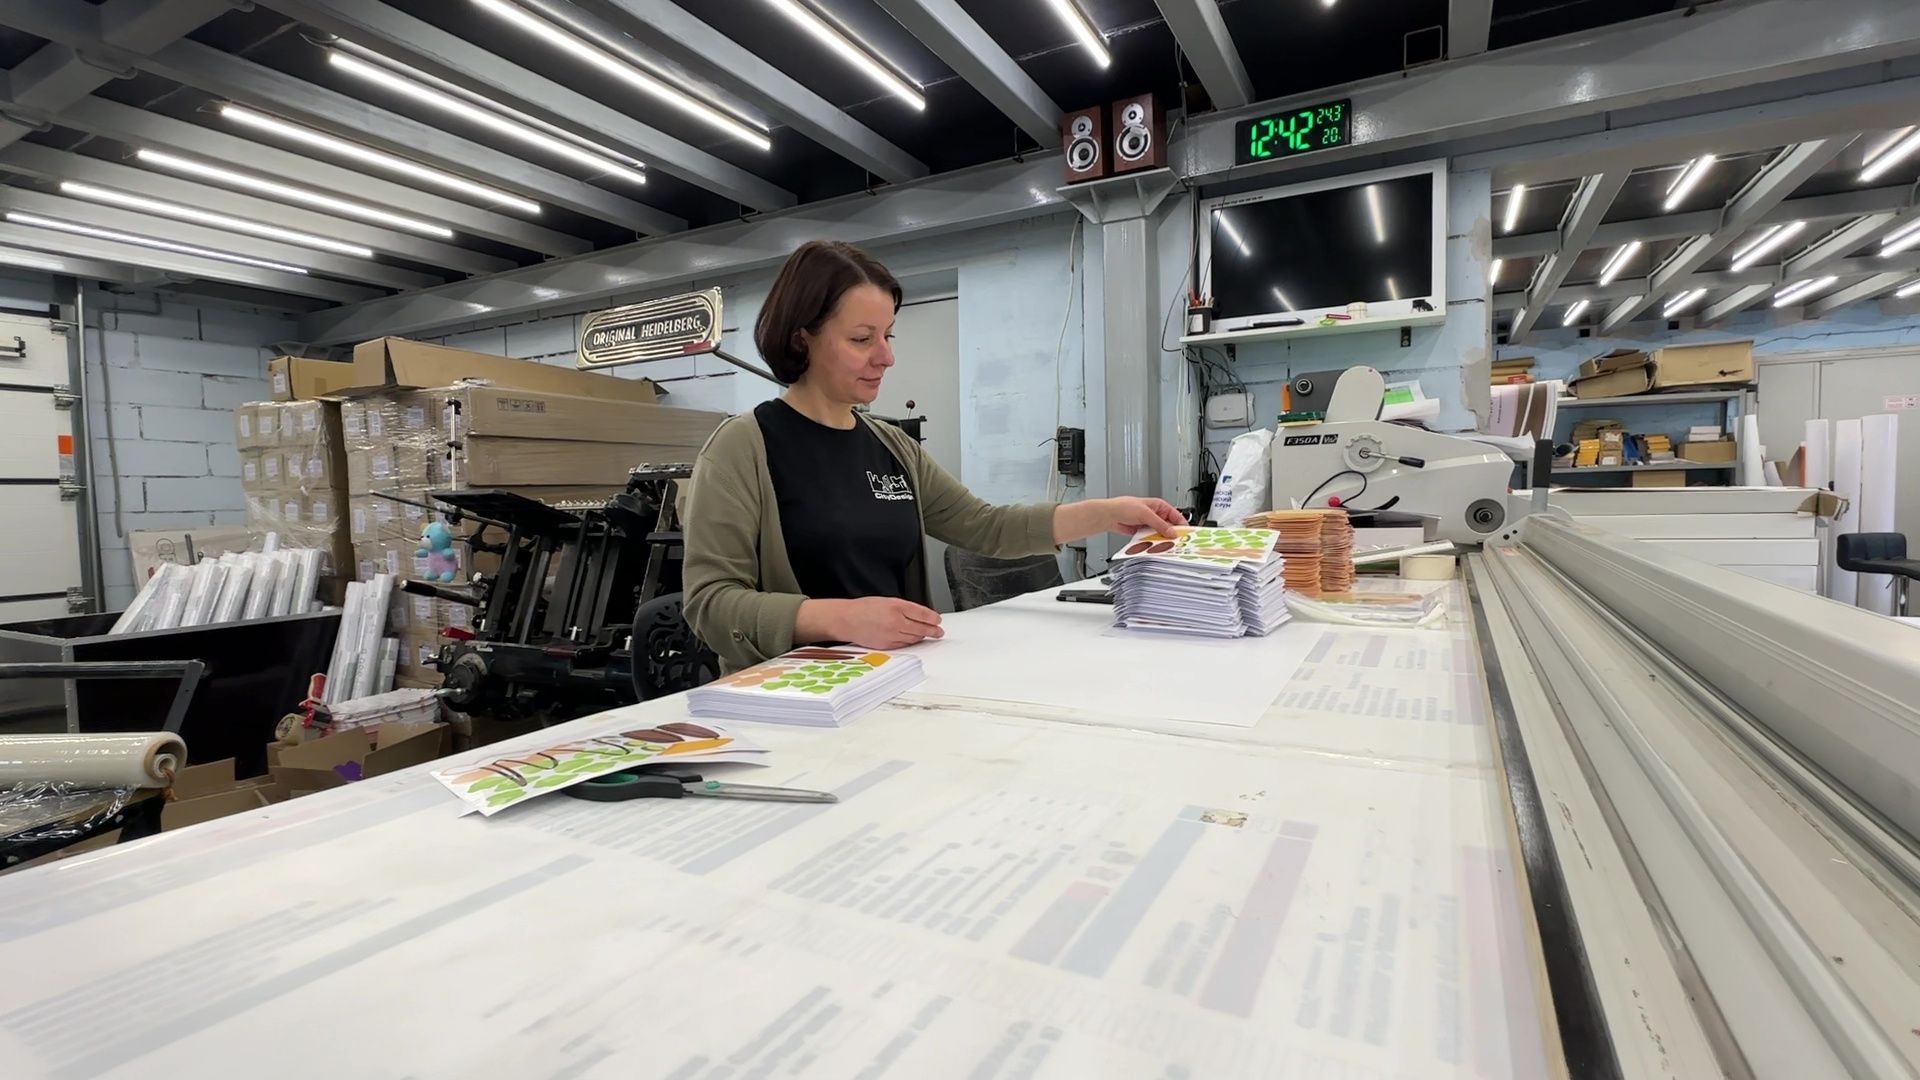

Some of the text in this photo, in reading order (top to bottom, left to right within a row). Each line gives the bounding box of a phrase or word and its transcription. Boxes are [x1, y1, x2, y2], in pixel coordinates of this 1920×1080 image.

[1250, 111, 1314, 157] 12:42
[593, 314, 706, 347] ORIGINAL HEIDELBERG
